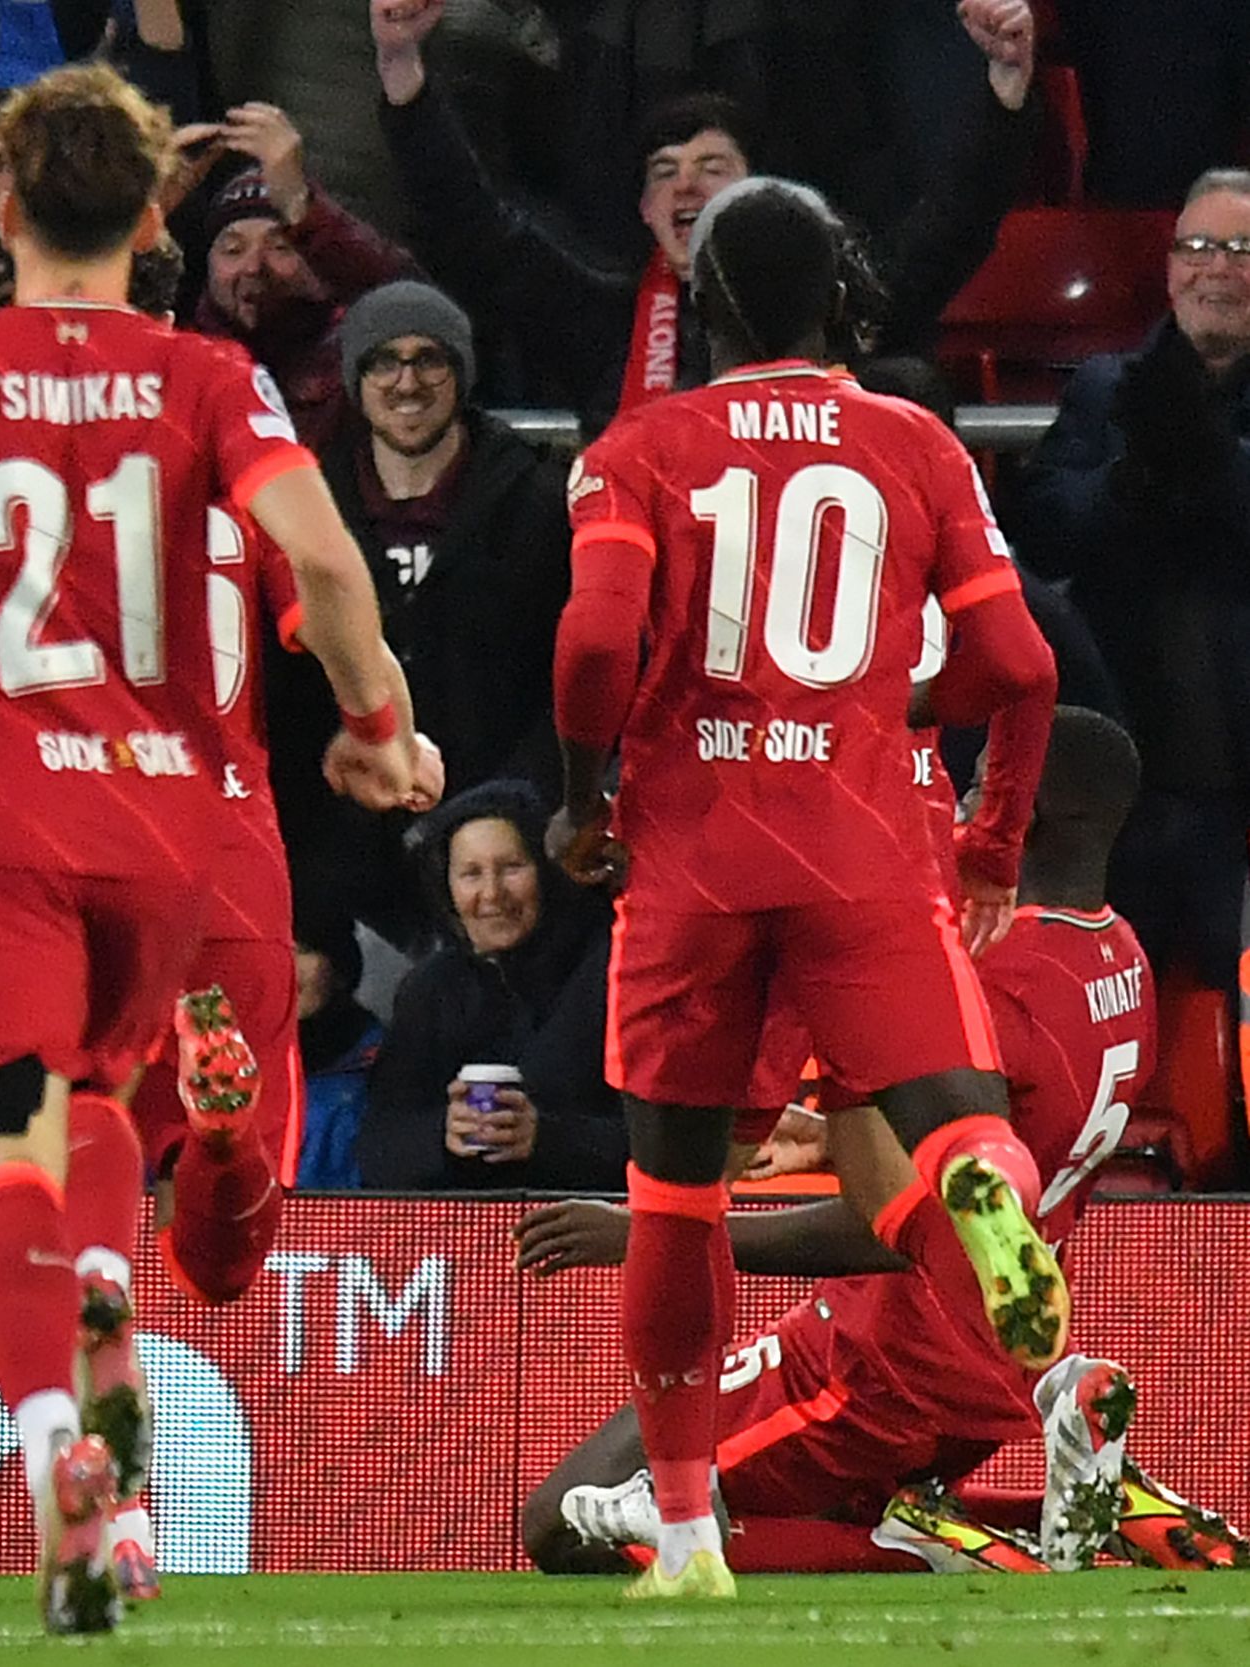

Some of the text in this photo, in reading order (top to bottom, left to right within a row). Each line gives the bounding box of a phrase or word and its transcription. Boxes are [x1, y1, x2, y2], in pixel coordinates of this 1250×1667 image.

[727, 399, 841, 447] MANÉ
[690, 462, 889, 690] 10
[36, 731, 113, 773] SIDE
[697, 718, 752, 762] SIDE
[765, 718, 833, 762] SIDE
[1084, 957, 1142, 1024] KONATÉ
[1037, 1040, 1139, 1217] 5
[263, 1251, 448, 1377] TM
